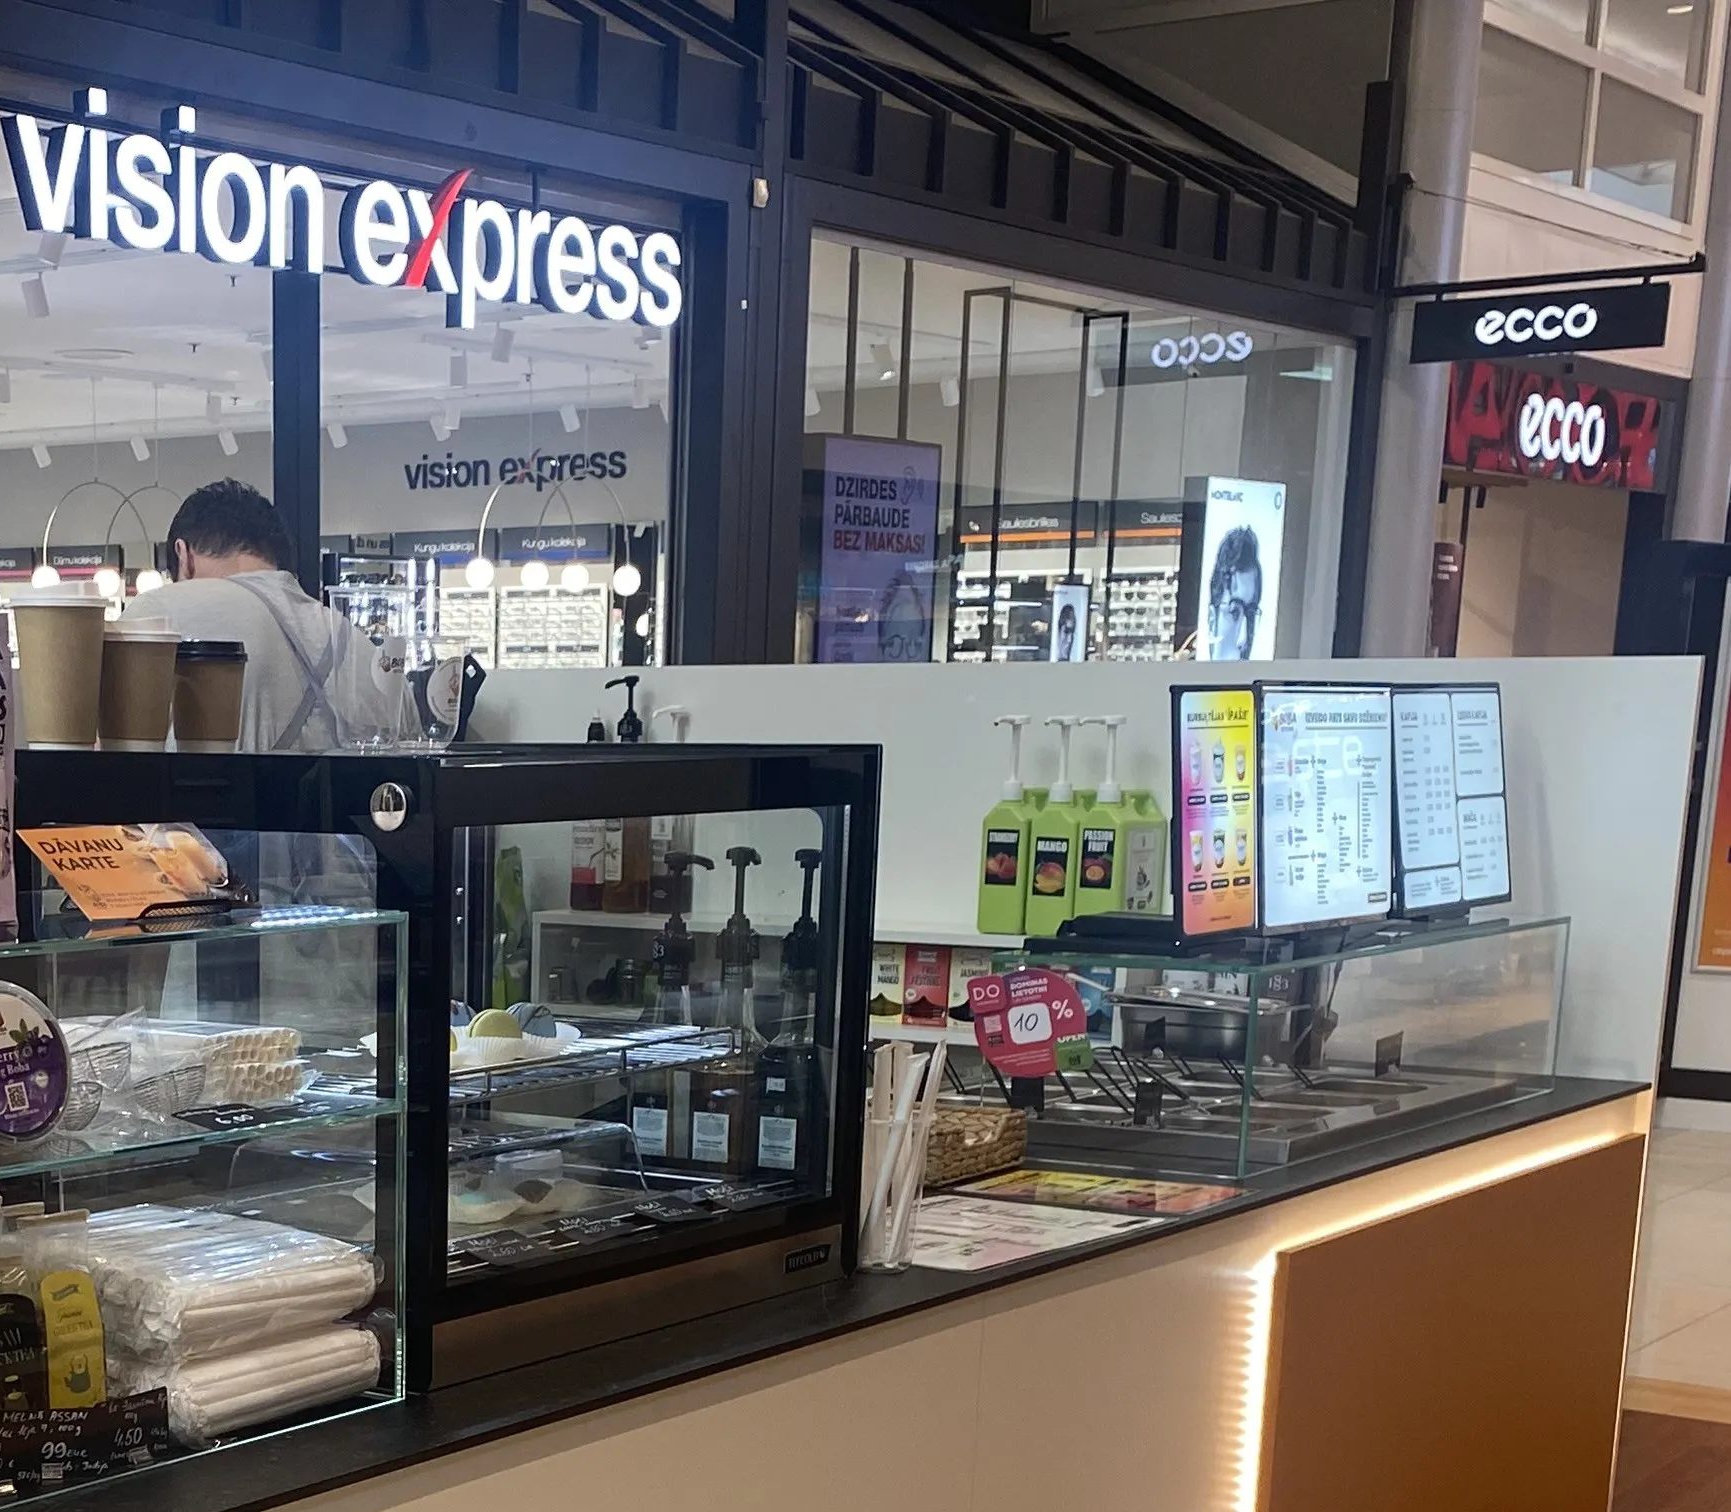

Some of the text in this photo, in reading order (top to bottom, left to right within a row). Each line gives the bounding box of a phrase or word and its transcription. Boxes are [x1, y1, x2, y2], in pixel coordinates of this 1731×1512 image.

[12, 86, 682, 330] vision express
[1475, 302, 1598, 345] ecco
[1519, 393, 1606, 467] ecco
[405, 449, 627, 491] vision express
[835, 476, 897, 500] DZIRDES
[834, 501, 911, 528] PĀRBAUDE
[833, 530, 926, 554] BEZ MAKSAS!
[37, 838, 124, 855] DĀVANU
[1037, 840, 1068, 852] MANGO
[52, 856, 121, 872] KARTE
[879, 964, 900, 973] WHITE
[973, 984, 1000, 1001] DO
[1014, 999, 1074, 1032] 10 %
[7, 1063, 31, 1075] Boba
